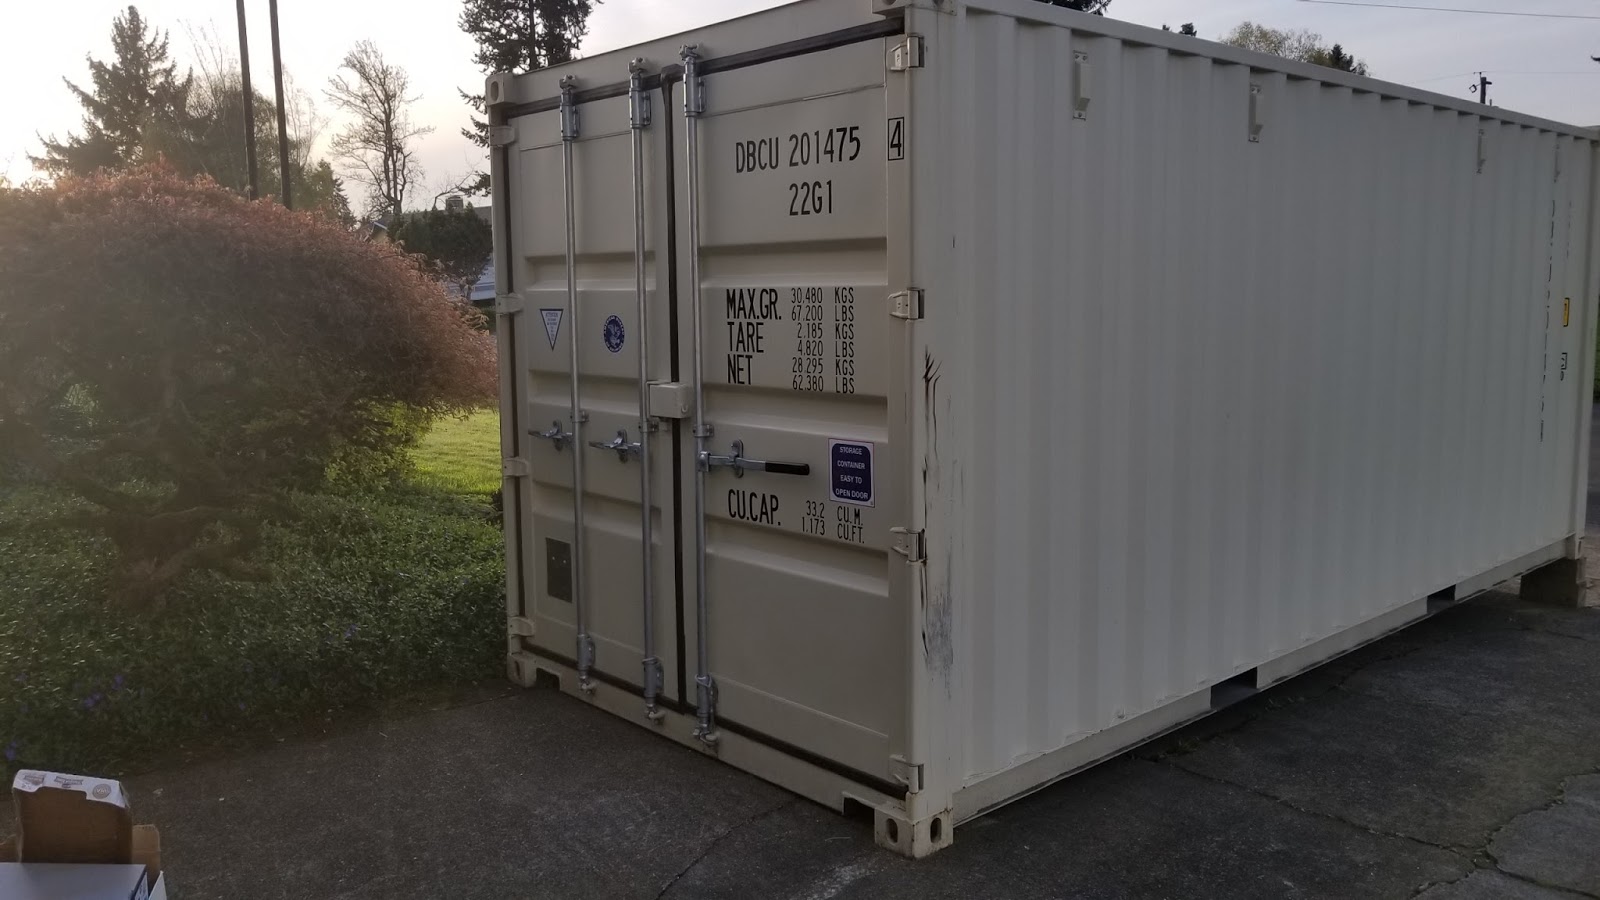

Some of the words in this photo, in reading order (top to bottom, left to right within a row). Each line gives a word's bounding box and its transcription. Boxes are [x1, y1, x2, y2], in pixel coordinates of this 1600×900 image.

[736, 136, 779, 173] DBCU
[789, 126, 861, 167] 201475
[890, 120, 902, 157] 4
[789, 180, 832, 216] 22G1
[726, 288, 782, 320] MAX.GR.
[834, 286, 855, 304] KGS
[834, 305, 855, 322] LBS
[727, 321, 764, 353] TARE
[835, 322, 855, 340] KGS
[835, 340, 855, 358] LBS
[727, 353, 753, 385] NET
[835, 359, 855, 376] KGS
[835, 376, 855, 394] LBS
[839, 446, 863, 456] STORAGE
[837, 460, 866, 470] CONTAINER
[840, 474, 855, 483] EASY
[855, 475, 863, 484] TO
[835, 488, 851, 498] OPEN
[851, 490, 869, 500] DOOR
[727, 488, 781, 526] CU.CAP.
[805, 500, 825, 519] 33.2
